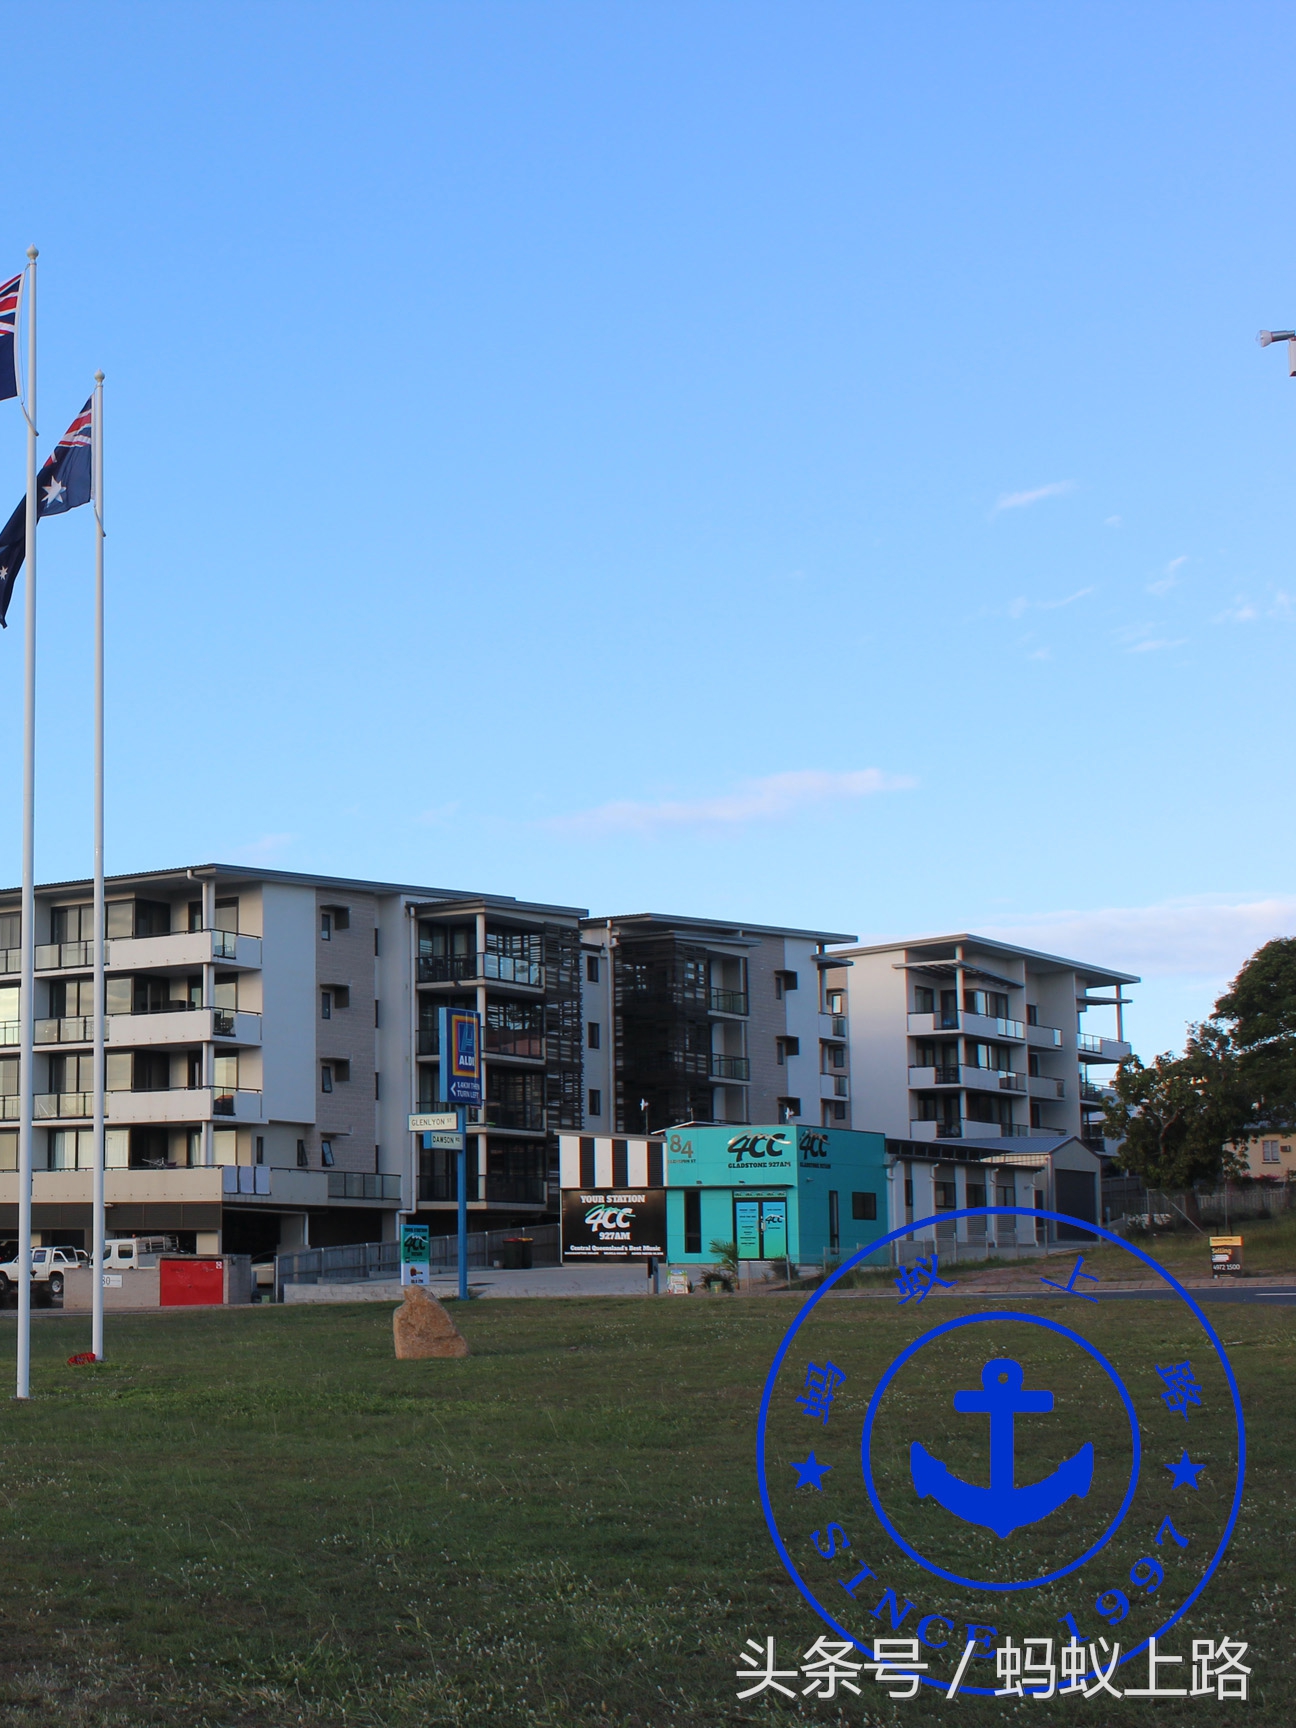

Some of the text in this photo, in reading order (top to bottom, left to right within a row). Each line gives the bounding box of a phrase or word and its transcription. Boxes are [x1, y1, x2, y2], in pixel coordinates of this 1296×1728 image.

[459, 1055, 475, 1066] ALDI
[411, 1118, 445, 1126] GLENLYON
[670, 1134, 694, 1158] 84
[727, 1130, 792, 1163] 4CC
[799, 1129, 831, 1160] 4CC
[580, 1194, 646, 1203] YOUR STATION
[585, 1204, 636, 1232] 4CC
[599, 1232, 631, 1240] 927AM
